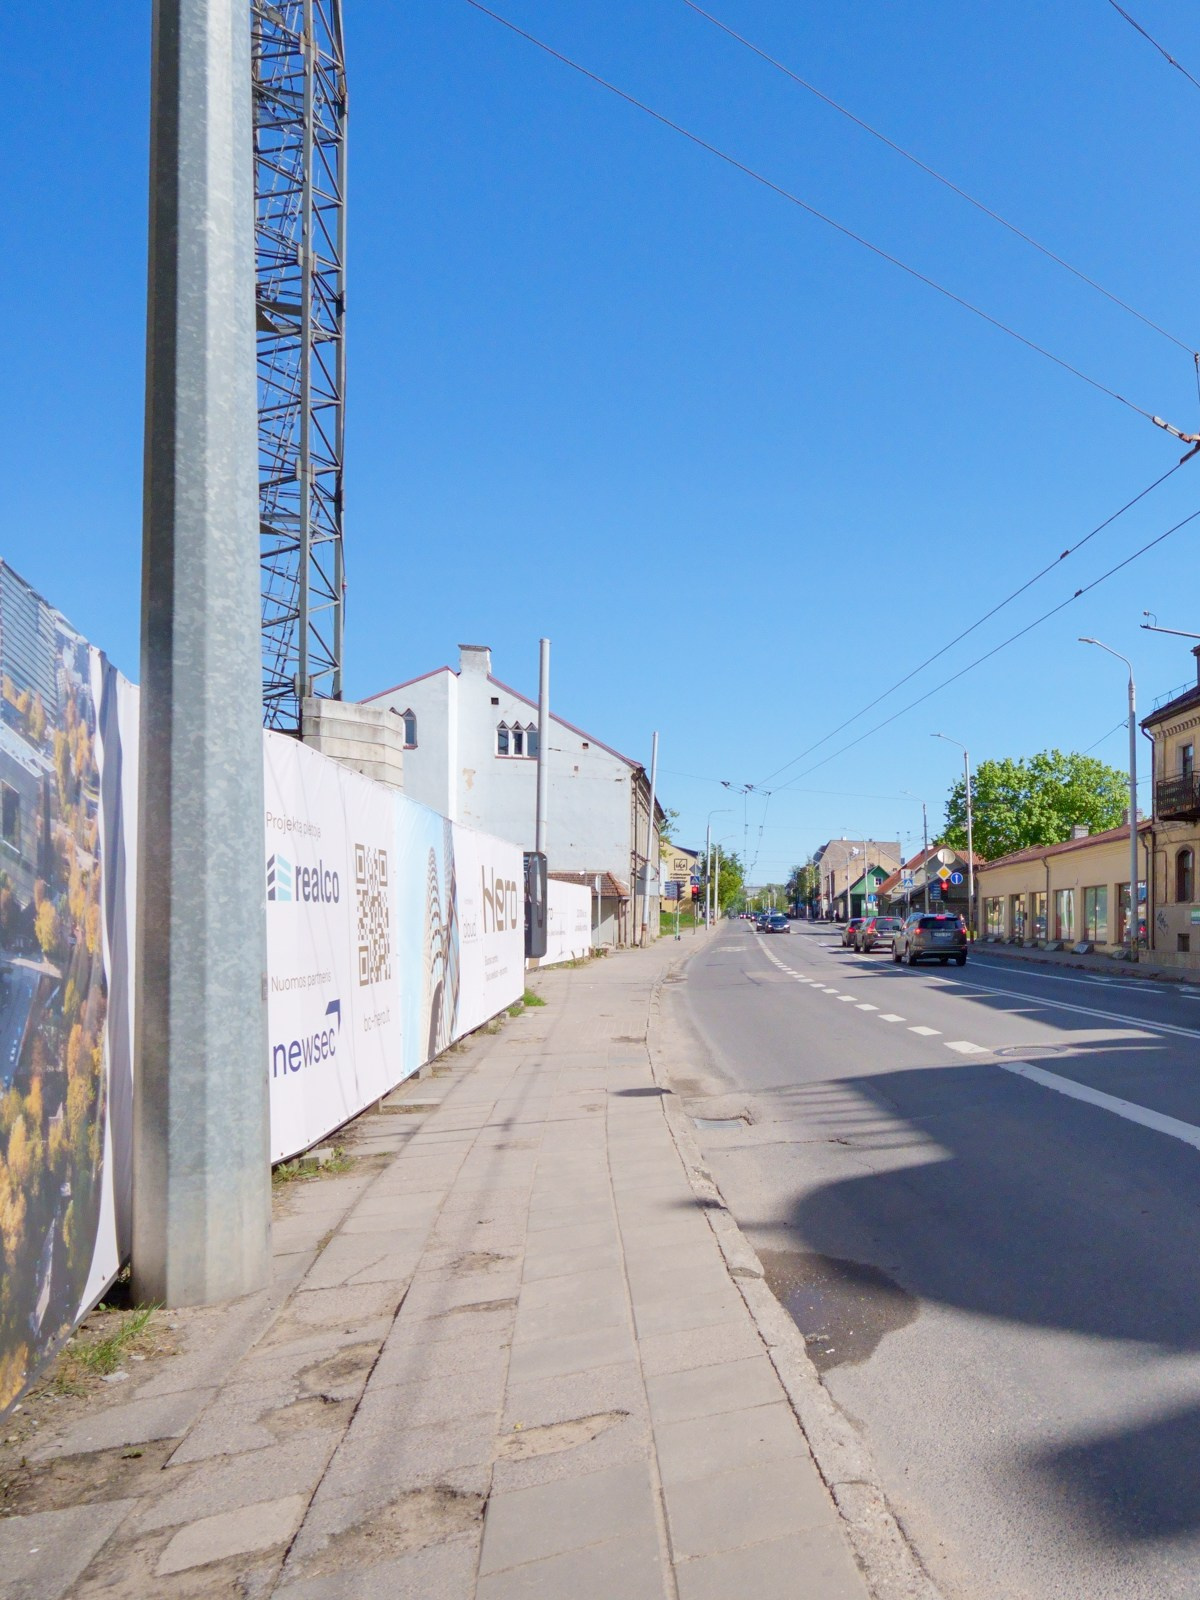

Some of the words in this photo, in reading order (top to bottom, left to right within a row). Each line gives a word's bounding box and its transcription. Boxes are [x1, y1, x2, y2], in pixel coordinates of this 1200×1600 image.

[295, 859, 340, 904] realco
[481, 864, 517, 934] Hero
[271, 975, 306, 992] Nuomos
[307, 968, 332, 991] partneris
[273, 1027, 336, 1078] newsec
